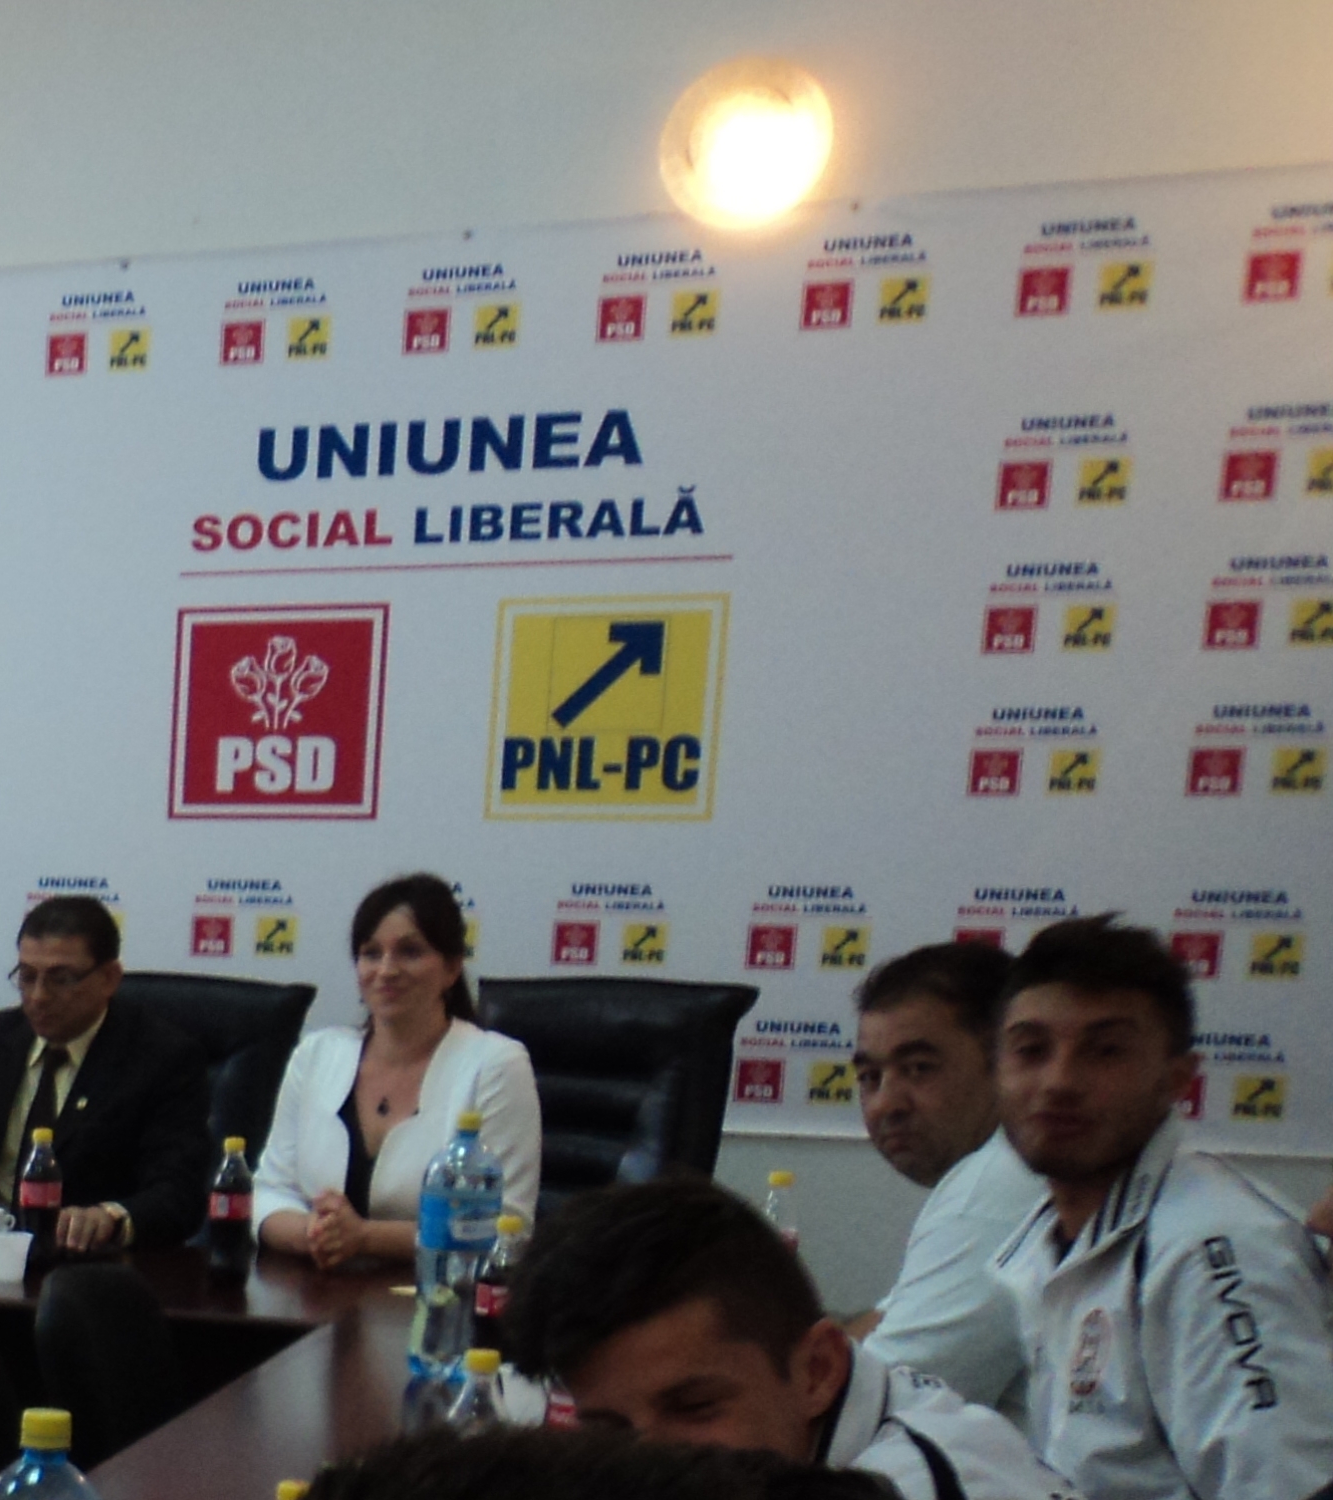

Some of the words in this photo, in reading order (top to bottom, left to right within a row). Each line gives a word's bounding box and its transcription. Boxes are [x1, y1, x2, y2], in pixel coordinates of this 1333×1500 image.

[822, 234, 913, 253] UNIUNEA
[616, 250, 703, 268] UNIUNEA
[422, 264, 504, 281] UNIUNEA
[237, 278, 314, 295] UNIUNEA
[61, 291, 135, 307] UNIUNEA
[810, 308, 842, 325] PSD
[606, 321, 636, 337] PSD
[412, 334, 440, 349] PSD
[228, 346, 255, 360] PSD
[54, 357, 79, 371] PSD
[1247, 403, 1333, 422] UNIUNE
[257, 409, 642, 481] UNIUNEA
[192, 509, 393, 552] SOCIAL
[413, 485, 704, 544] LIBERALĂ
[215, 736, 335, 794] PSD
[501, 736, 701, 792] PNL-PC
[38, 875, 108, 888] UNIUNEA
[206, 877, 281, 890] UNIUNEA
[570, 881, 652, 895] UNIUNEA
[766, 884, 853, 898] UNIUNEA
[198, 938, 224, 950] PSD
[560, 945, 588, 958] PSD
[755, 949, 785, 963] PSD
[754, 1021, 840, 1036] UNIUNEA
[1204, 1235, 1278, 1412] GIVOVA
